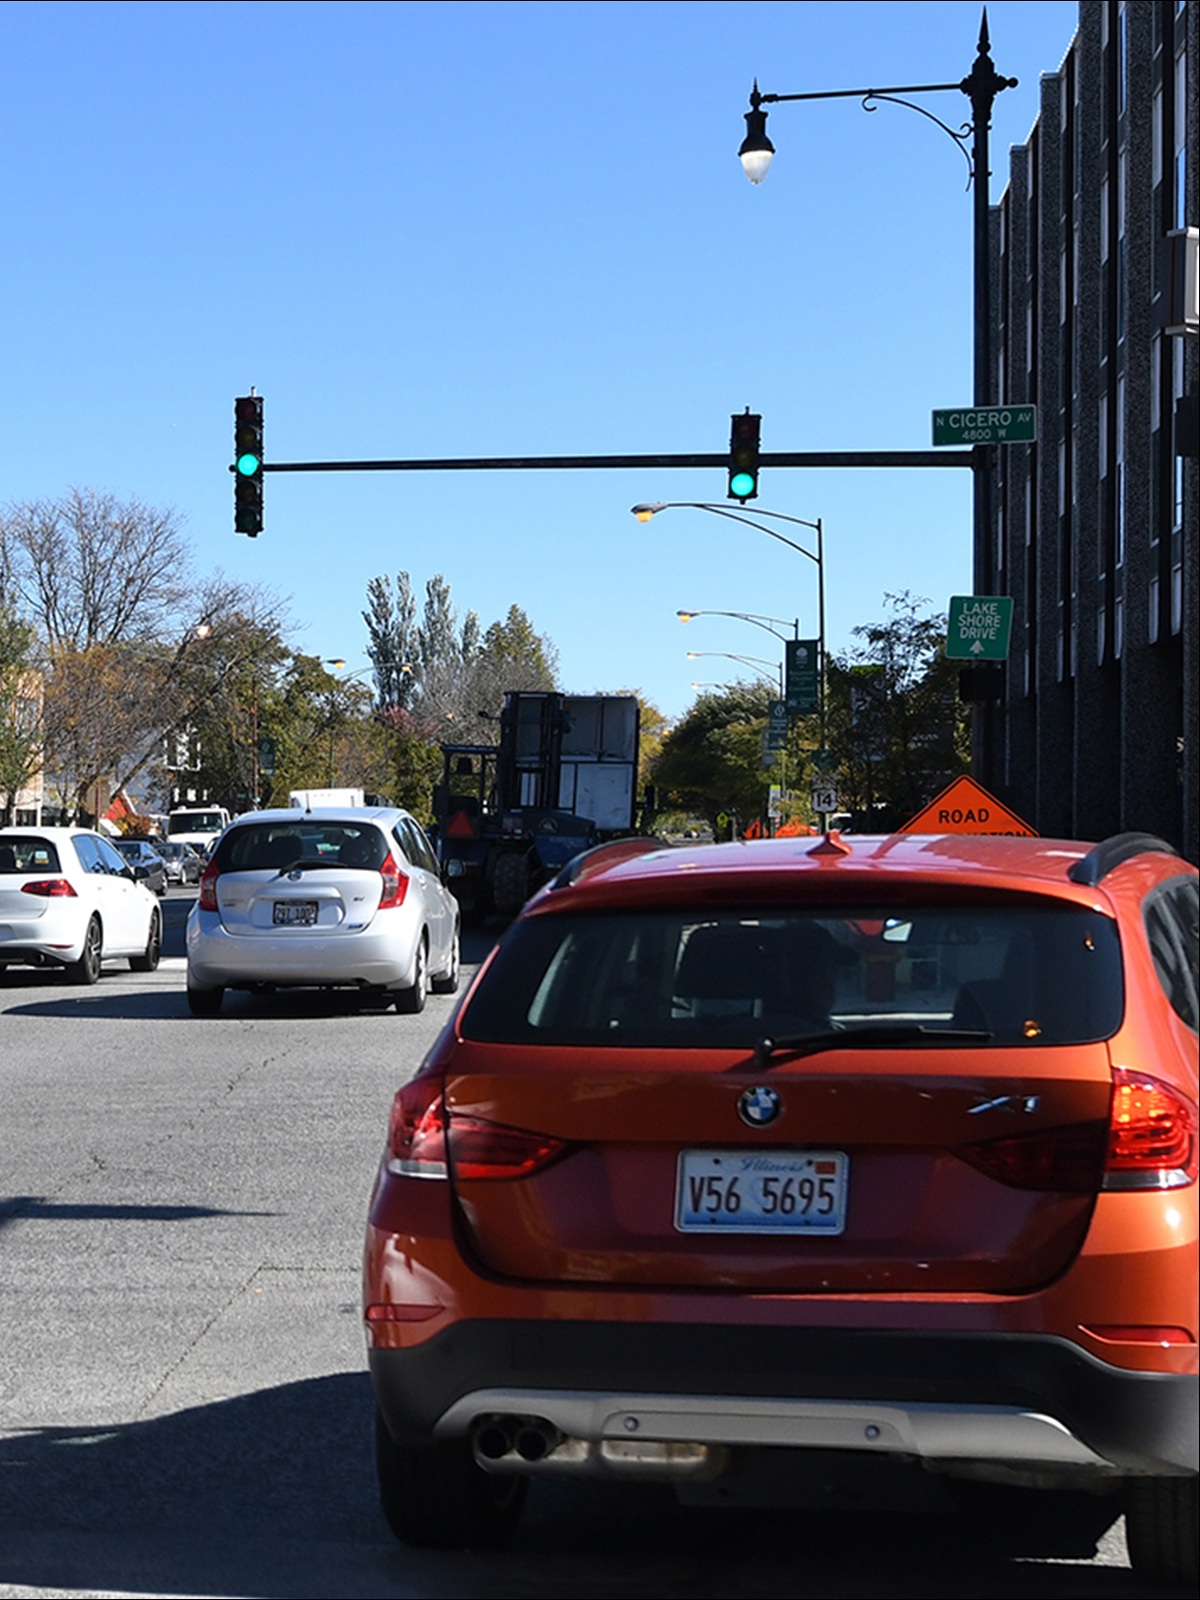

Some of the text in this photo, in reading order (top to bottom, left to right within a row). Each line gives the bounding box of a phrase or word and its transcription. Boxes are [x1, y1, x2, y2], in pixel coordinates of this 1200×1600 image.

[936, 411, 1032, 428] N CICERO AV
[962, 428, 1008, 440] 4800 W
[963, 603, 998, 615] LAKE
[958, 614, 1002, 627] SHORE
[960, 627, 997, 640] DRIVE
[816, 793, 832, 808] 14
[938, 808, 990, 824] ROAD
[740, 1158, 804, 1172] Illinois
[689, 1176, 836, 1215] V56 5695
